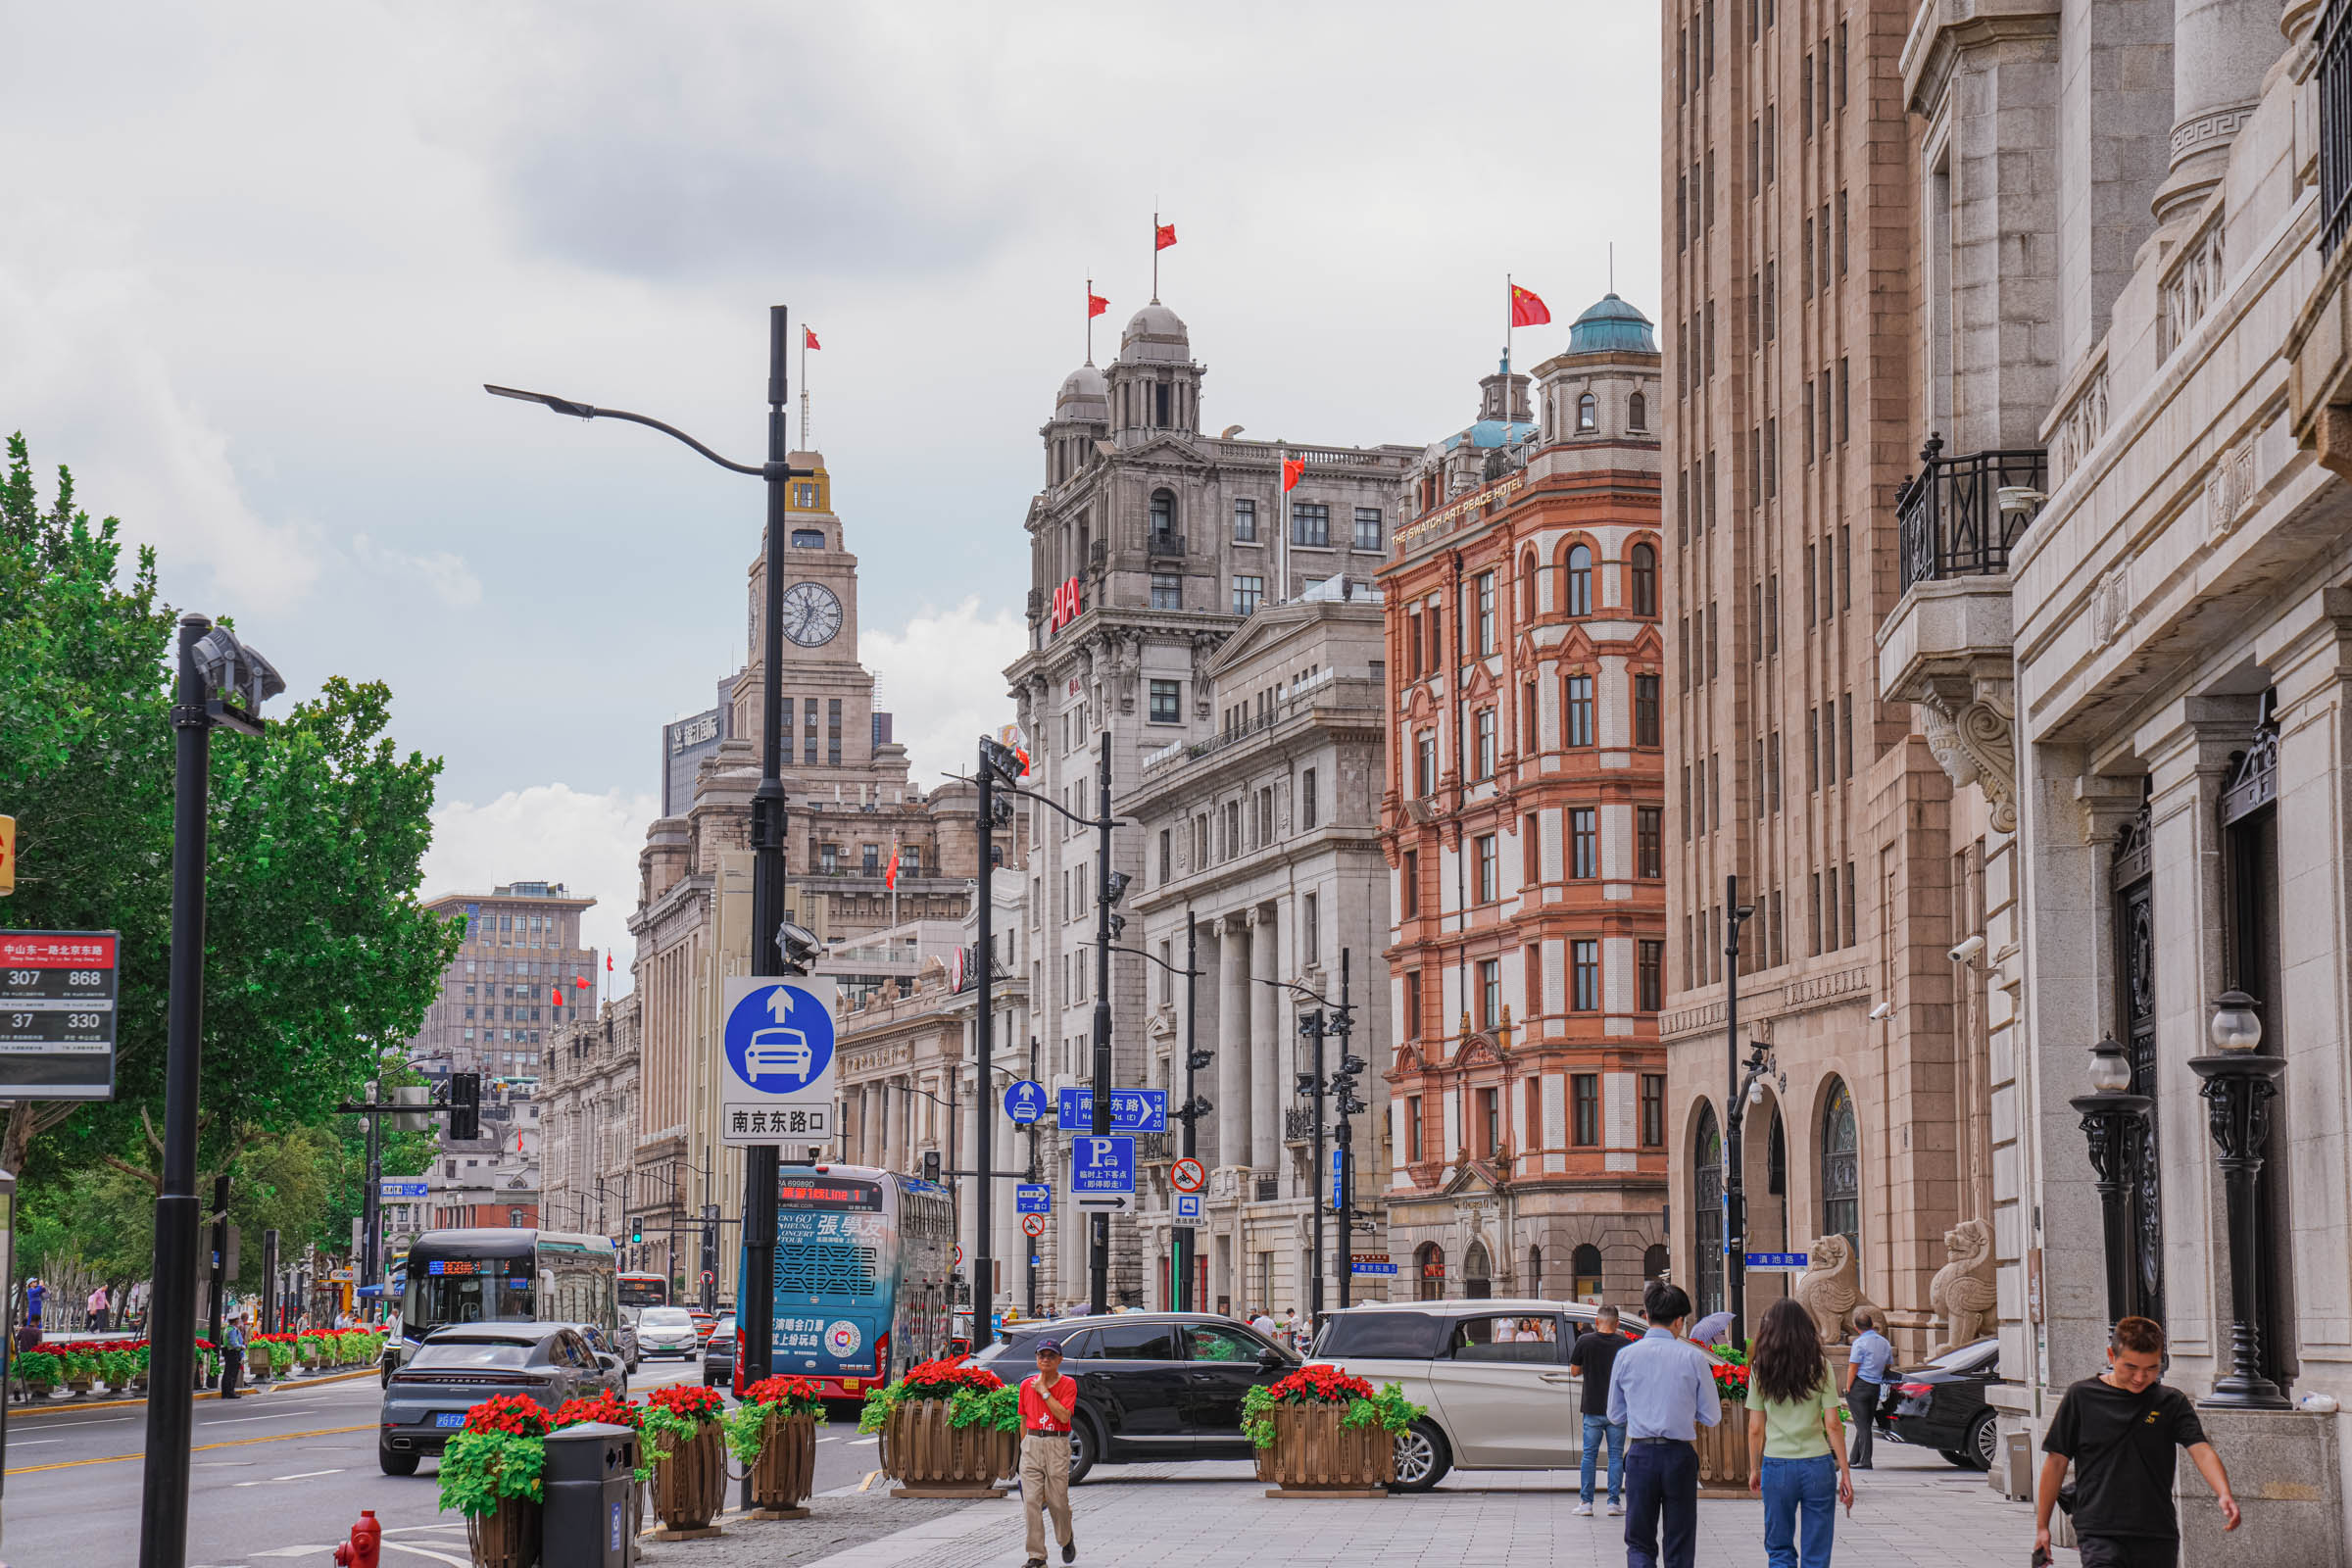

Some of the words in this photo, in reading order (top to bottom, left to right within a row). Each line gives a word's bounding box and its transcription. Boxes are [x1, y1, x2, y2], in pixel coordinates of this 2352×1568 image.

[1392, 530, 1406, 546] THE
[1407, 514, 1443, 538] SWATCH
[1444, 504, 1462, 522] ART
[1463, 491, 1493, 513] PEACE
[1494, 477, 1523, 499] HOTEL
[1051, 575, 1082, 635] AIA
[4, 944, 103, 956] 中山东一路北京东路
[8, 970, 40, 985] 307
[69, 971, 101, 986] 868
[12, 1013, 33, 1028] 37
[68, 1013, 100, 1028] 330
[1063, 1102, 1072, 1110] 东
[1080, 1098, 1139, 1112] 南东路
[732, 1110, 824, 1134] 南京东路口
[1089, 1139, 1113, 1168] P
[1079, 1170, 1127, 1179] 临时上下客点
[817, 1215, 882, 1237] 張學友
[773, 1317, 824, 1332] 演唱会门票
